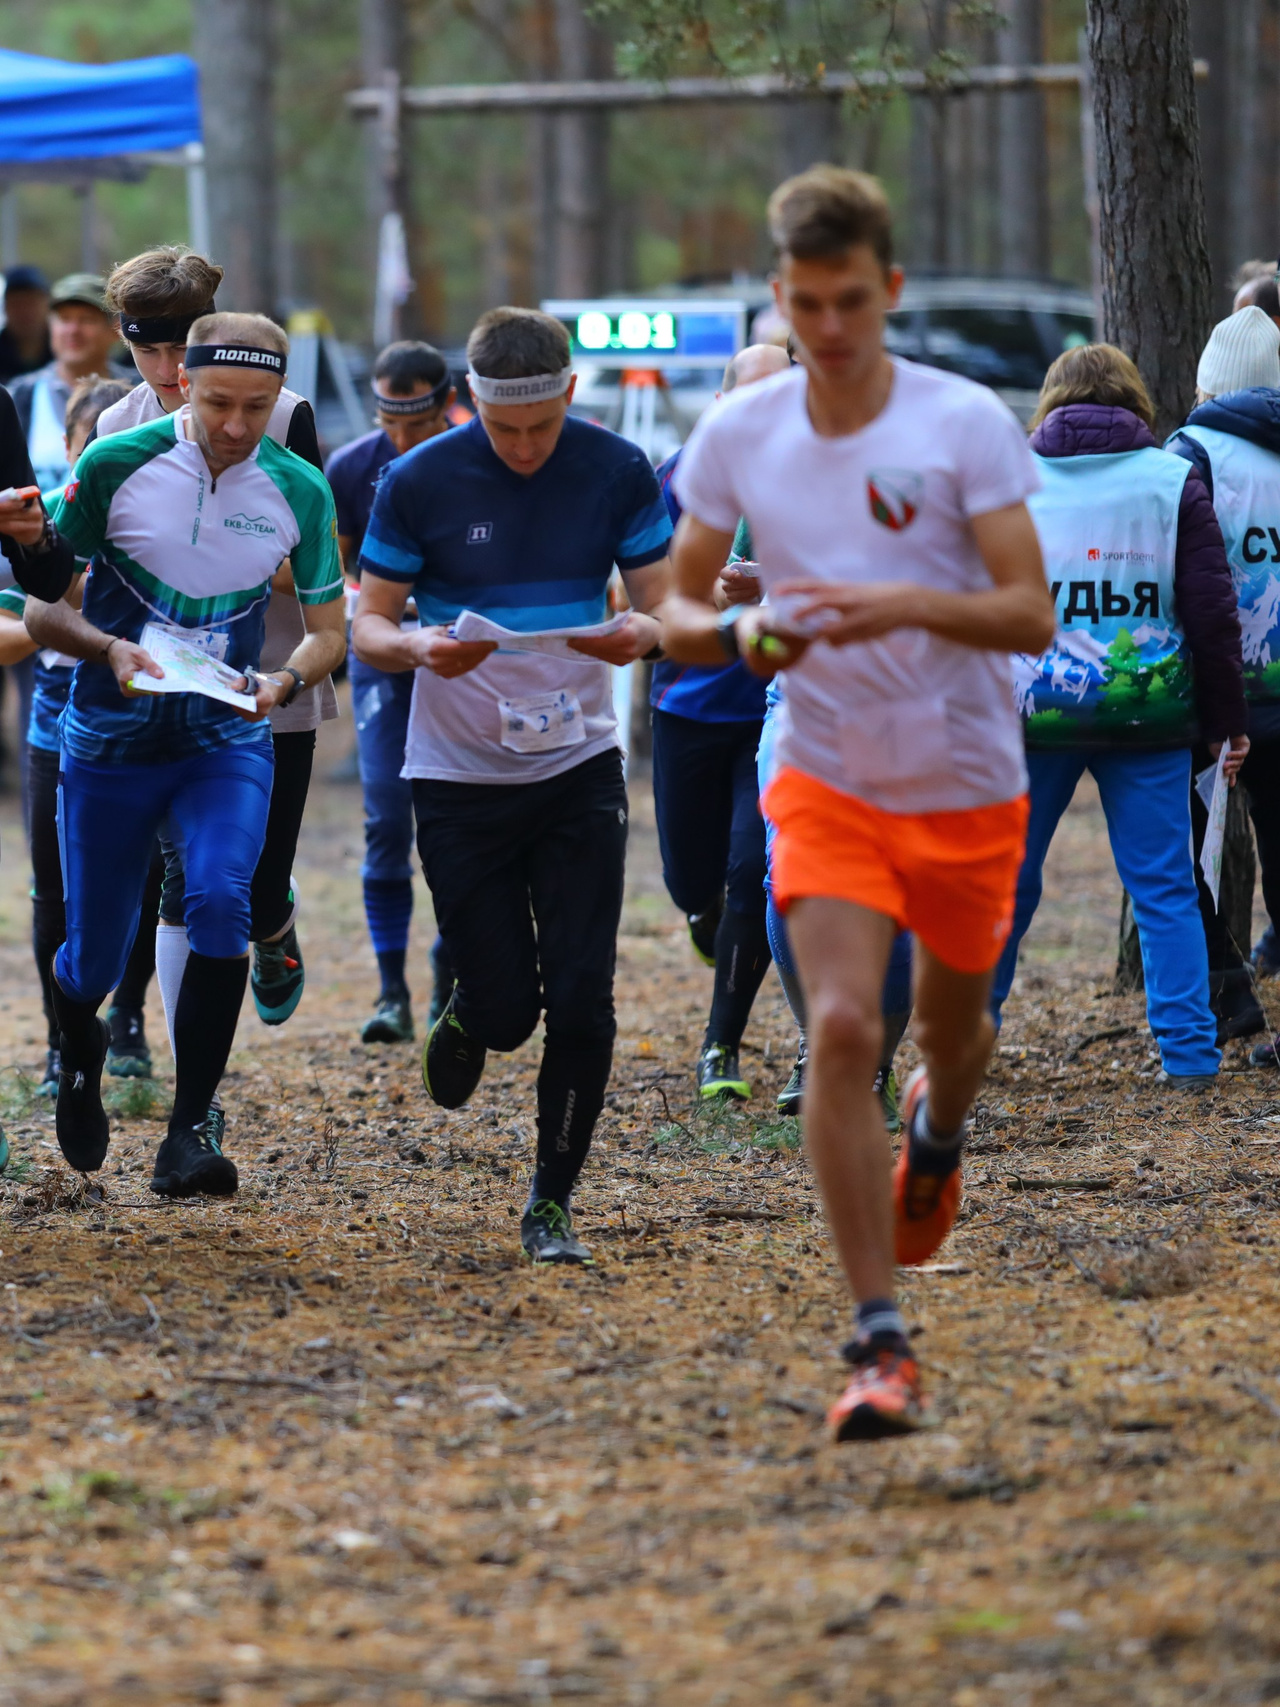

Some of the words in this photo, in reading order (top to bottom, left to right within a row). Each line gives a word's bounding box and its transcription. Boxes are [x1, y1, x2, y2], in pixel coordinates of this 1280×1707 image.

[213, 348, 281, 368] noname
[224, 519, 277, 535] EKB-O-TEAM
[539, 714, 550, 733] 2
